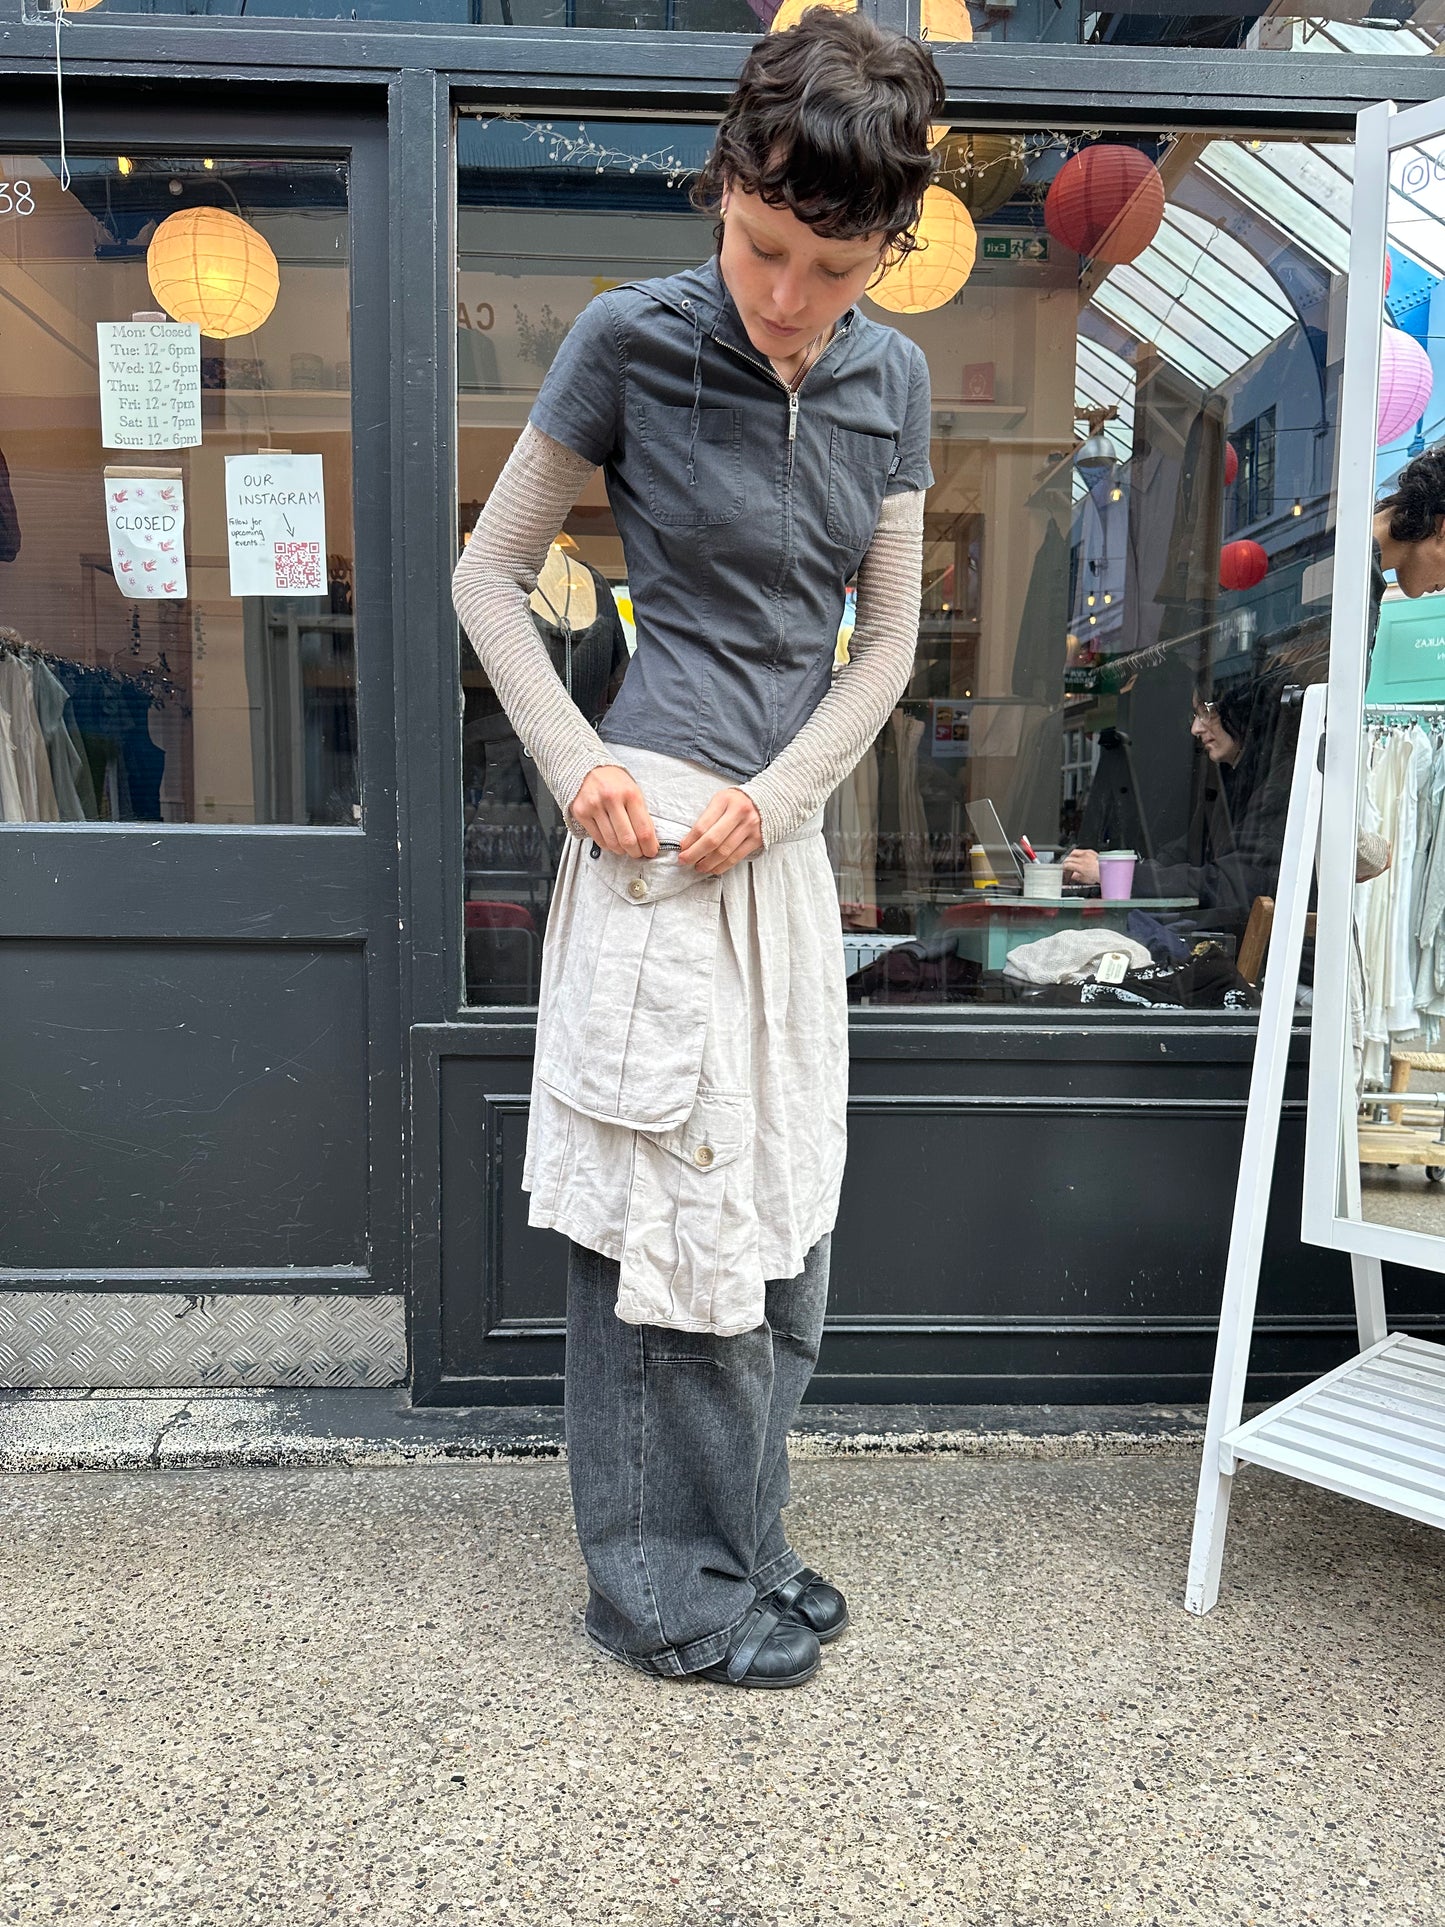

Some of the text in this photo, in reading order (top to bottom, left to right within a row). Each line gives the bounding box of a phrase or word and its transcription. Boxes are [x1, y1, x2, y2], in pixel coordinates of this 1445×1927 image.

[112, 325, 192, 338] Mon: Closed
[110, 344, 140, 356] Tue:
[168, 344, 196, 358] 6pm
[109, 362, 144, 374] Wed:
[172, 362, 199, 377] 6pm
[107, 379, 139, 392] Thu:
[172, 379, 198, 394] 7pm
[119, 397, 141, 410] Fri:
[169, 398, 195, 413] 7pm
[119, 415, 142, 428] Sat:
[171, 416, 195, 430] 7pm
[114, 432, 143, 445] Sun:
[172, 432, 198, 447] 6pm
[243, 473, 274, 487] OUR
[239, 491, 321, 506] INSTAGRAM
[115, 515, 176, 532] CLOSED
[250, 517, 262, 531] for
[231, 529, 266, 541] upcoming
